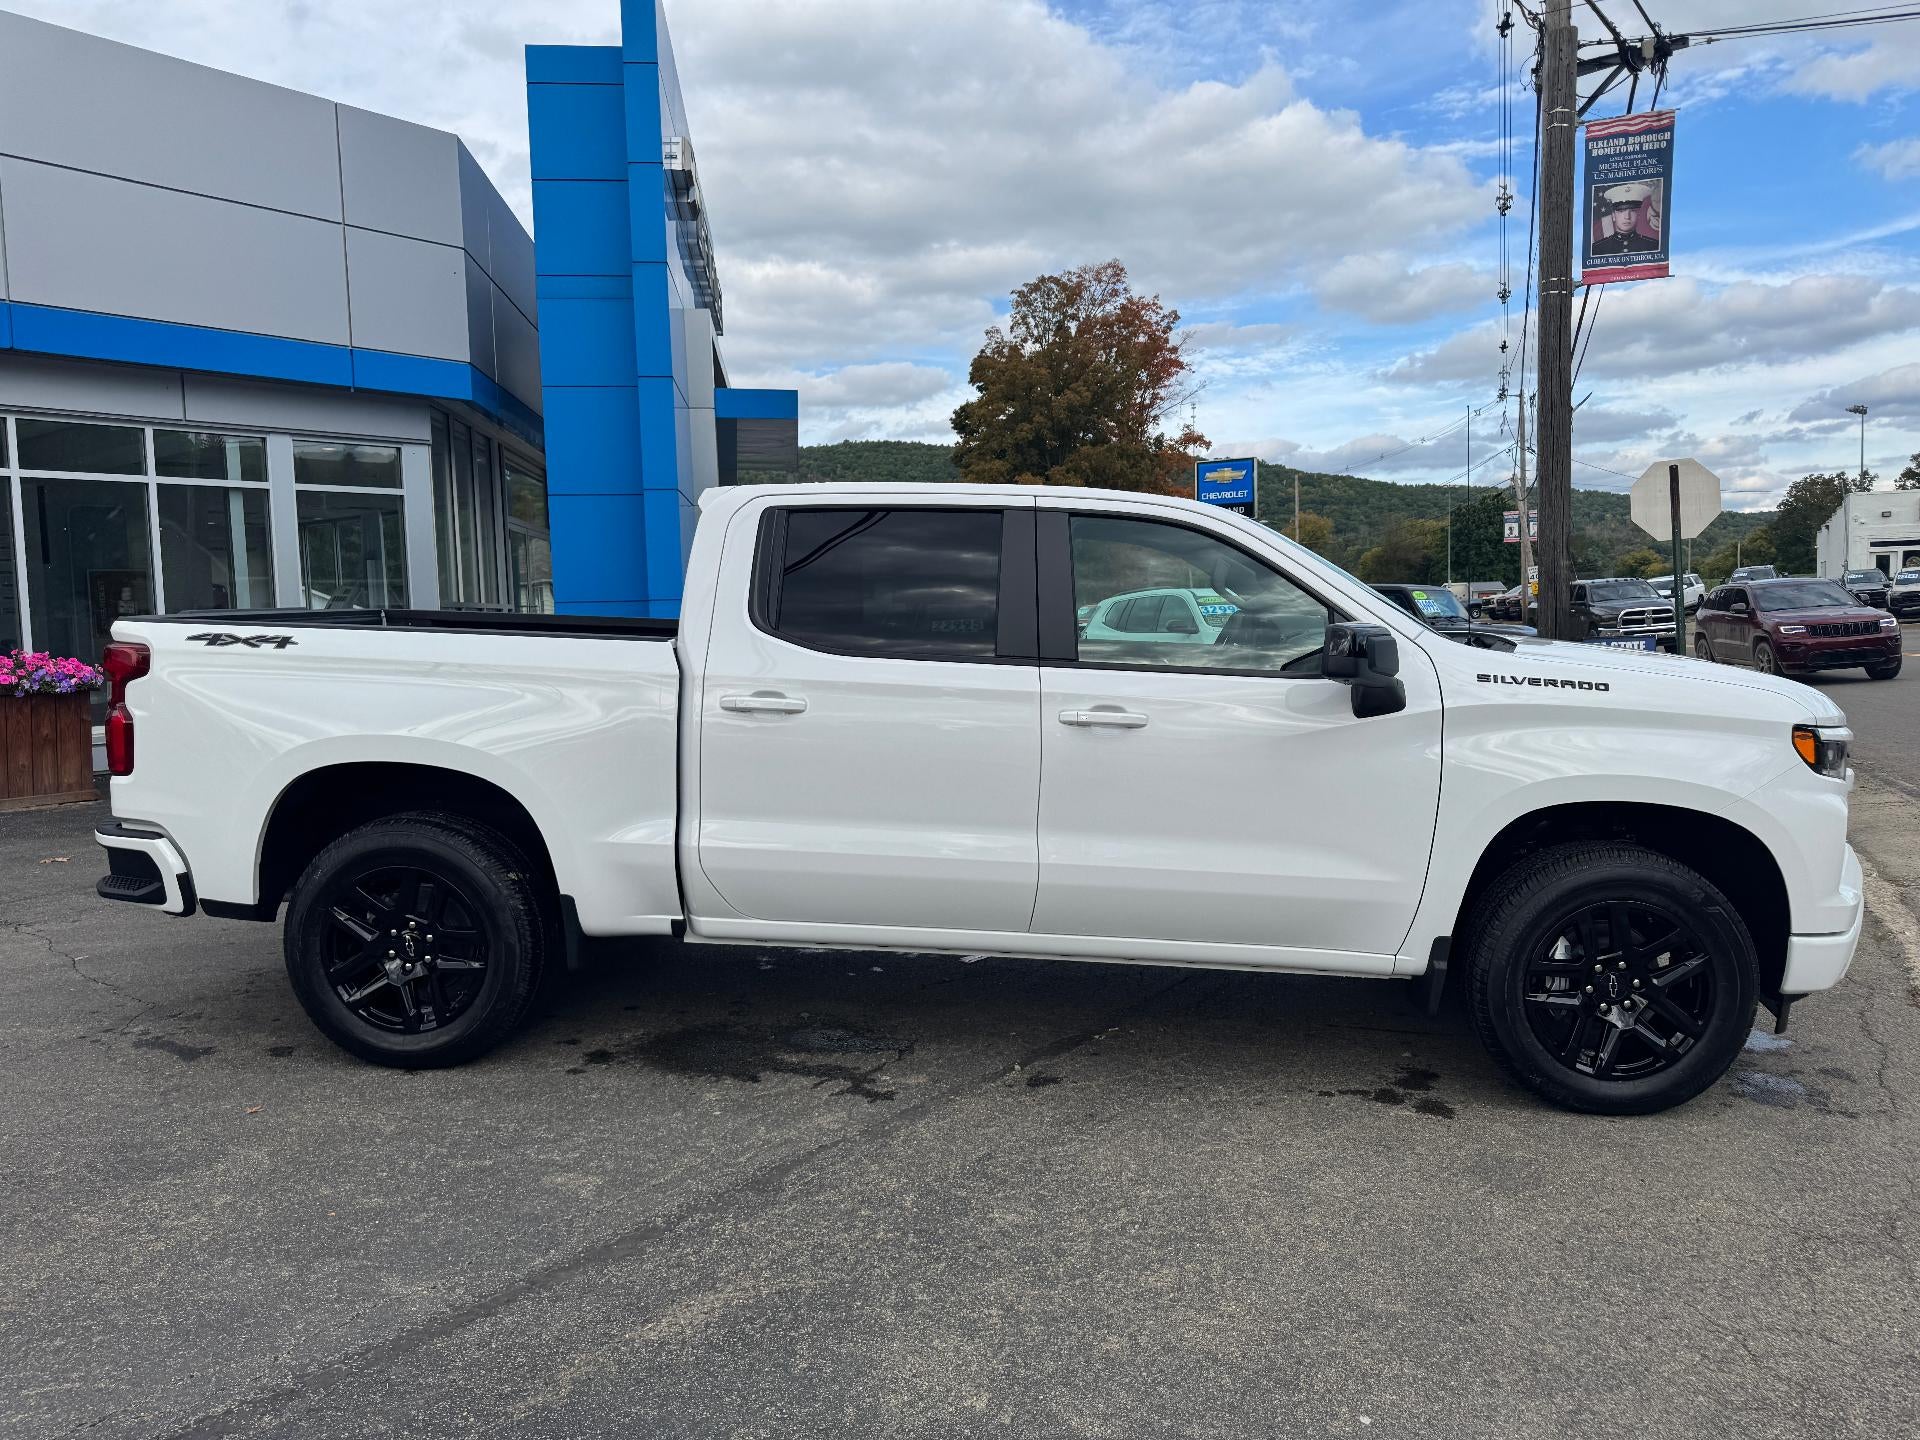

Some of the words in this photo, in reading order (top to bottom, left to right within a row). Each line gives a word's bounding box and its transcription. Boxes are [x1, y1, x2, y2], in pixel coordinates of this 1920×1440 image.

[1588, 138, 1626, 150] ELKLAND
[1628, 132, 1671, 144] BOROUGH
[1592, 144, 1640, 156] HOMETOWN
[1642, 140, 1667, 151] HERO
[1599, 162, 1630, 170] MICHAEL
[1634, 158, 1658, 166] PLANK
[1608, 170, 1636, 178] MARINE
[1638, 167, 1663, 175] CORPS
[1202, 490, 1248, 500] CHEVROLET
[1476, 674, 1610, 692] SILVERADO
